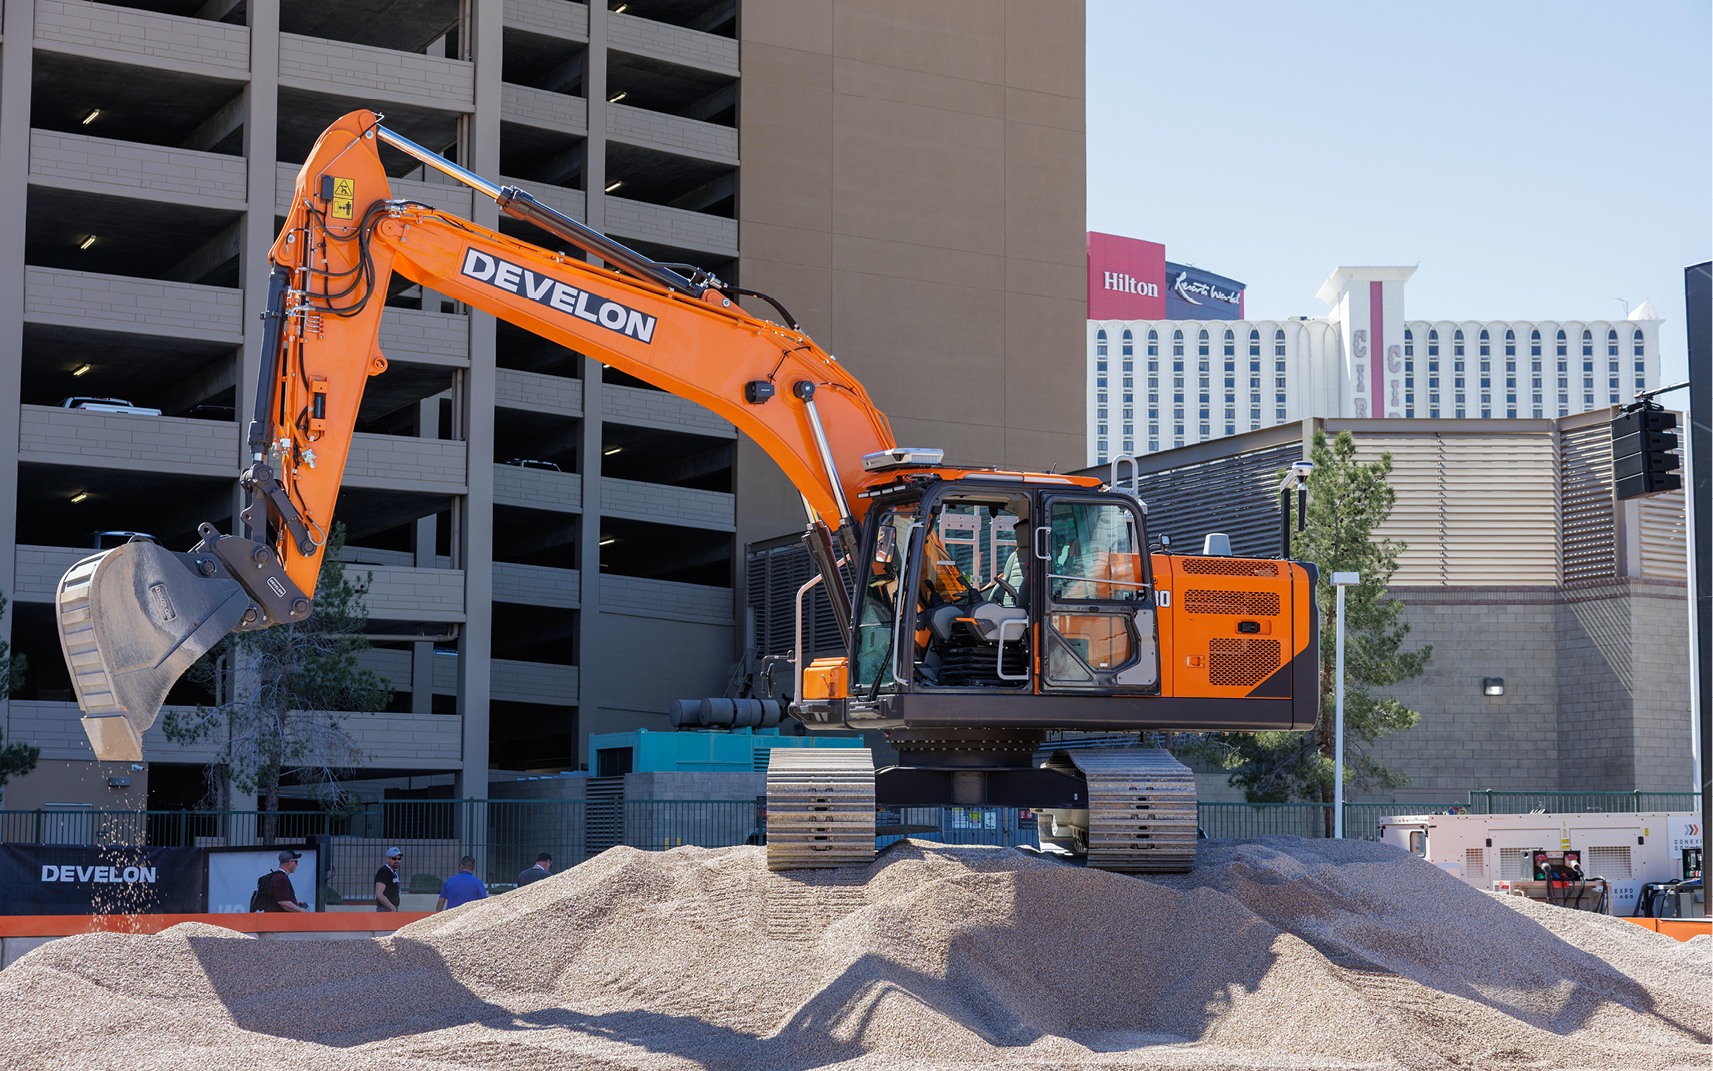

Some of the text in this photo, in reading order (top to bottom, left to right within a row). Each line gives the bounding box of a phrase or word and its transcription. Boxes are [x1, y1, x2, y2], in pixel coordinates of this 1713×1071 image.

[463, 249, 655, 342] DEVELON
[1104, 271, 1158, 298] Hilton
[1174, 271, 1240, 305] Resorts World
[41, 865, 156, 883] DEVELON
